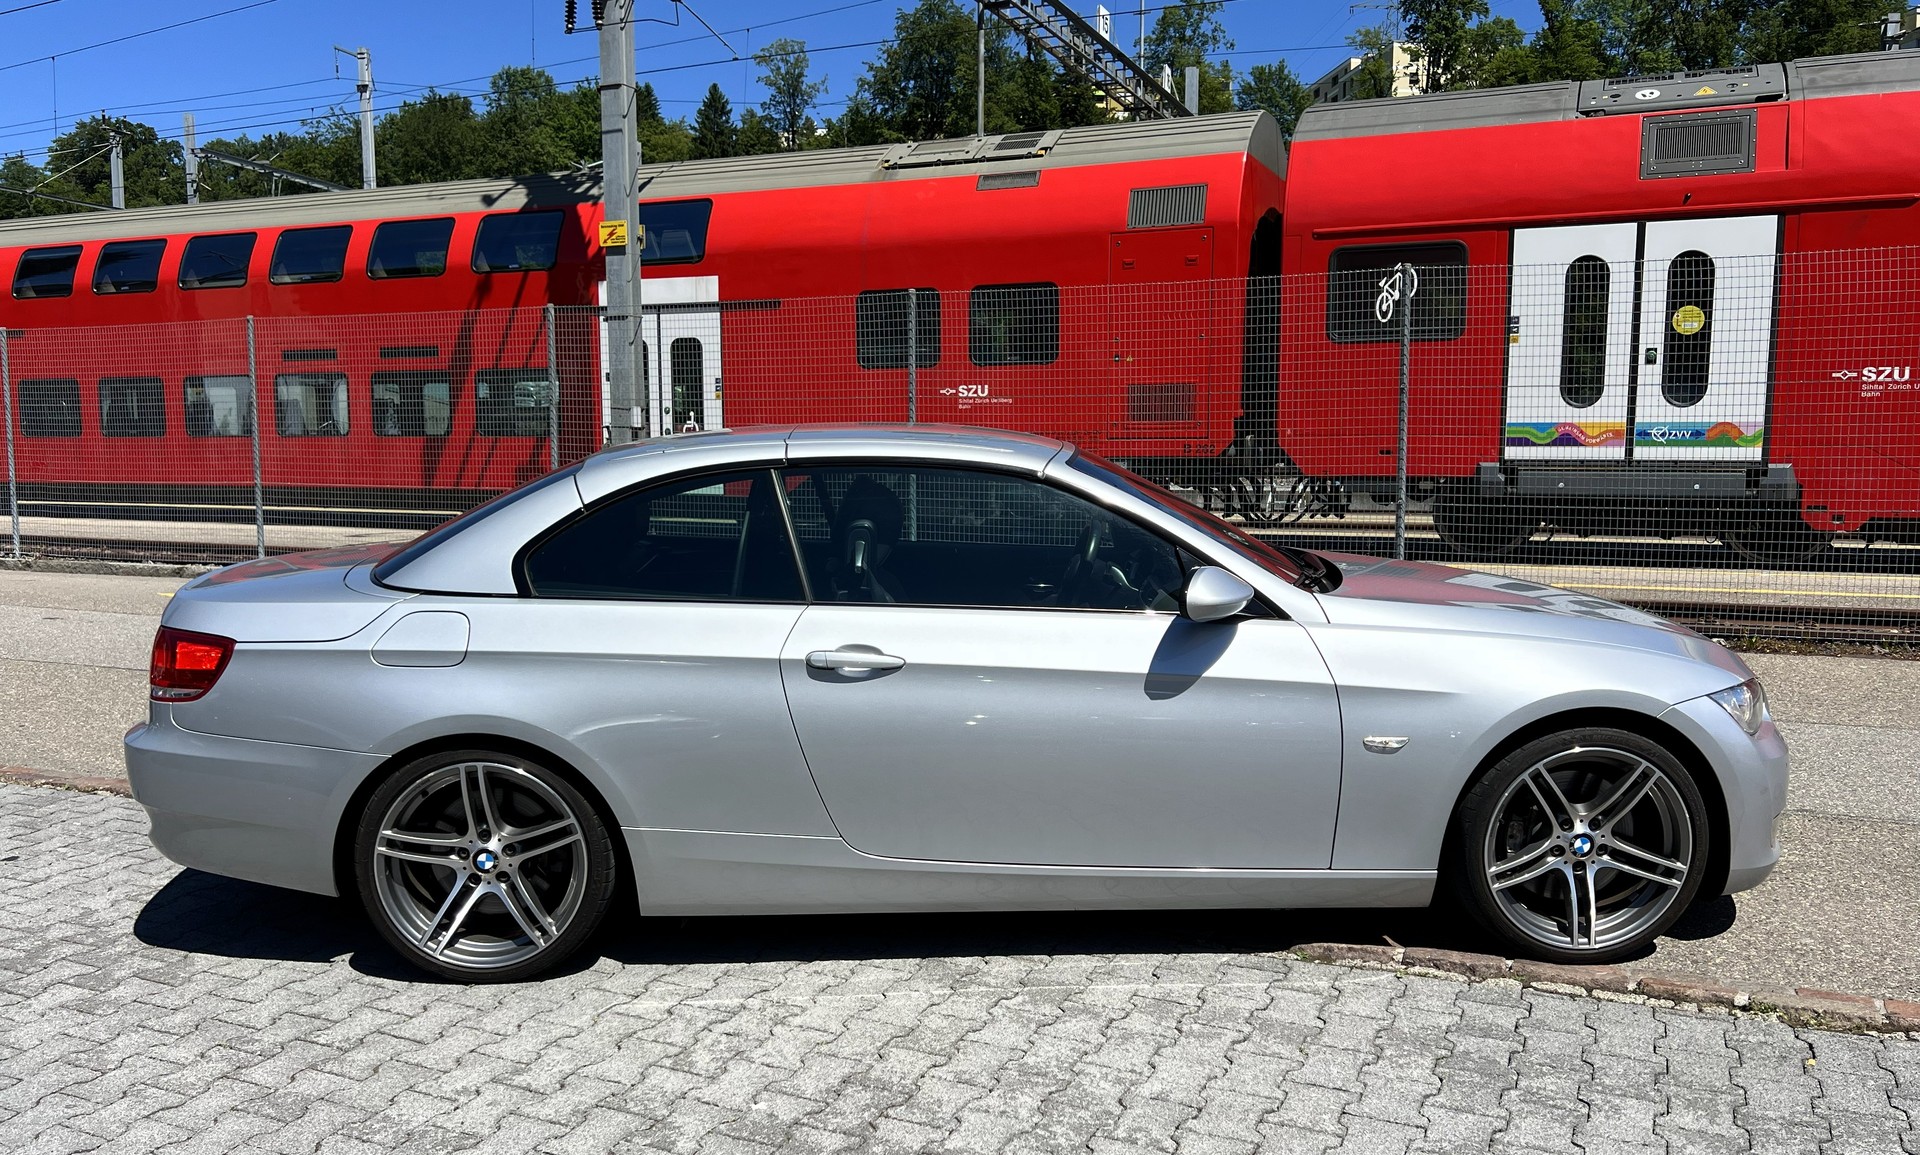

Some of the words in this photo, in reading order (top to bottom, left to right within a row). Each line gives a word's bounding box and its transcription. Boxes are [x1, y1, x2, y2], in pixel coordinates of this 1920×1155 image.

[1102, 15, 1109, 34] 15
[1862, 366, 1910, 382] SZU
[958, 384, 989, 397] SZU
[1669, 430, 1692, 440] ZVV
